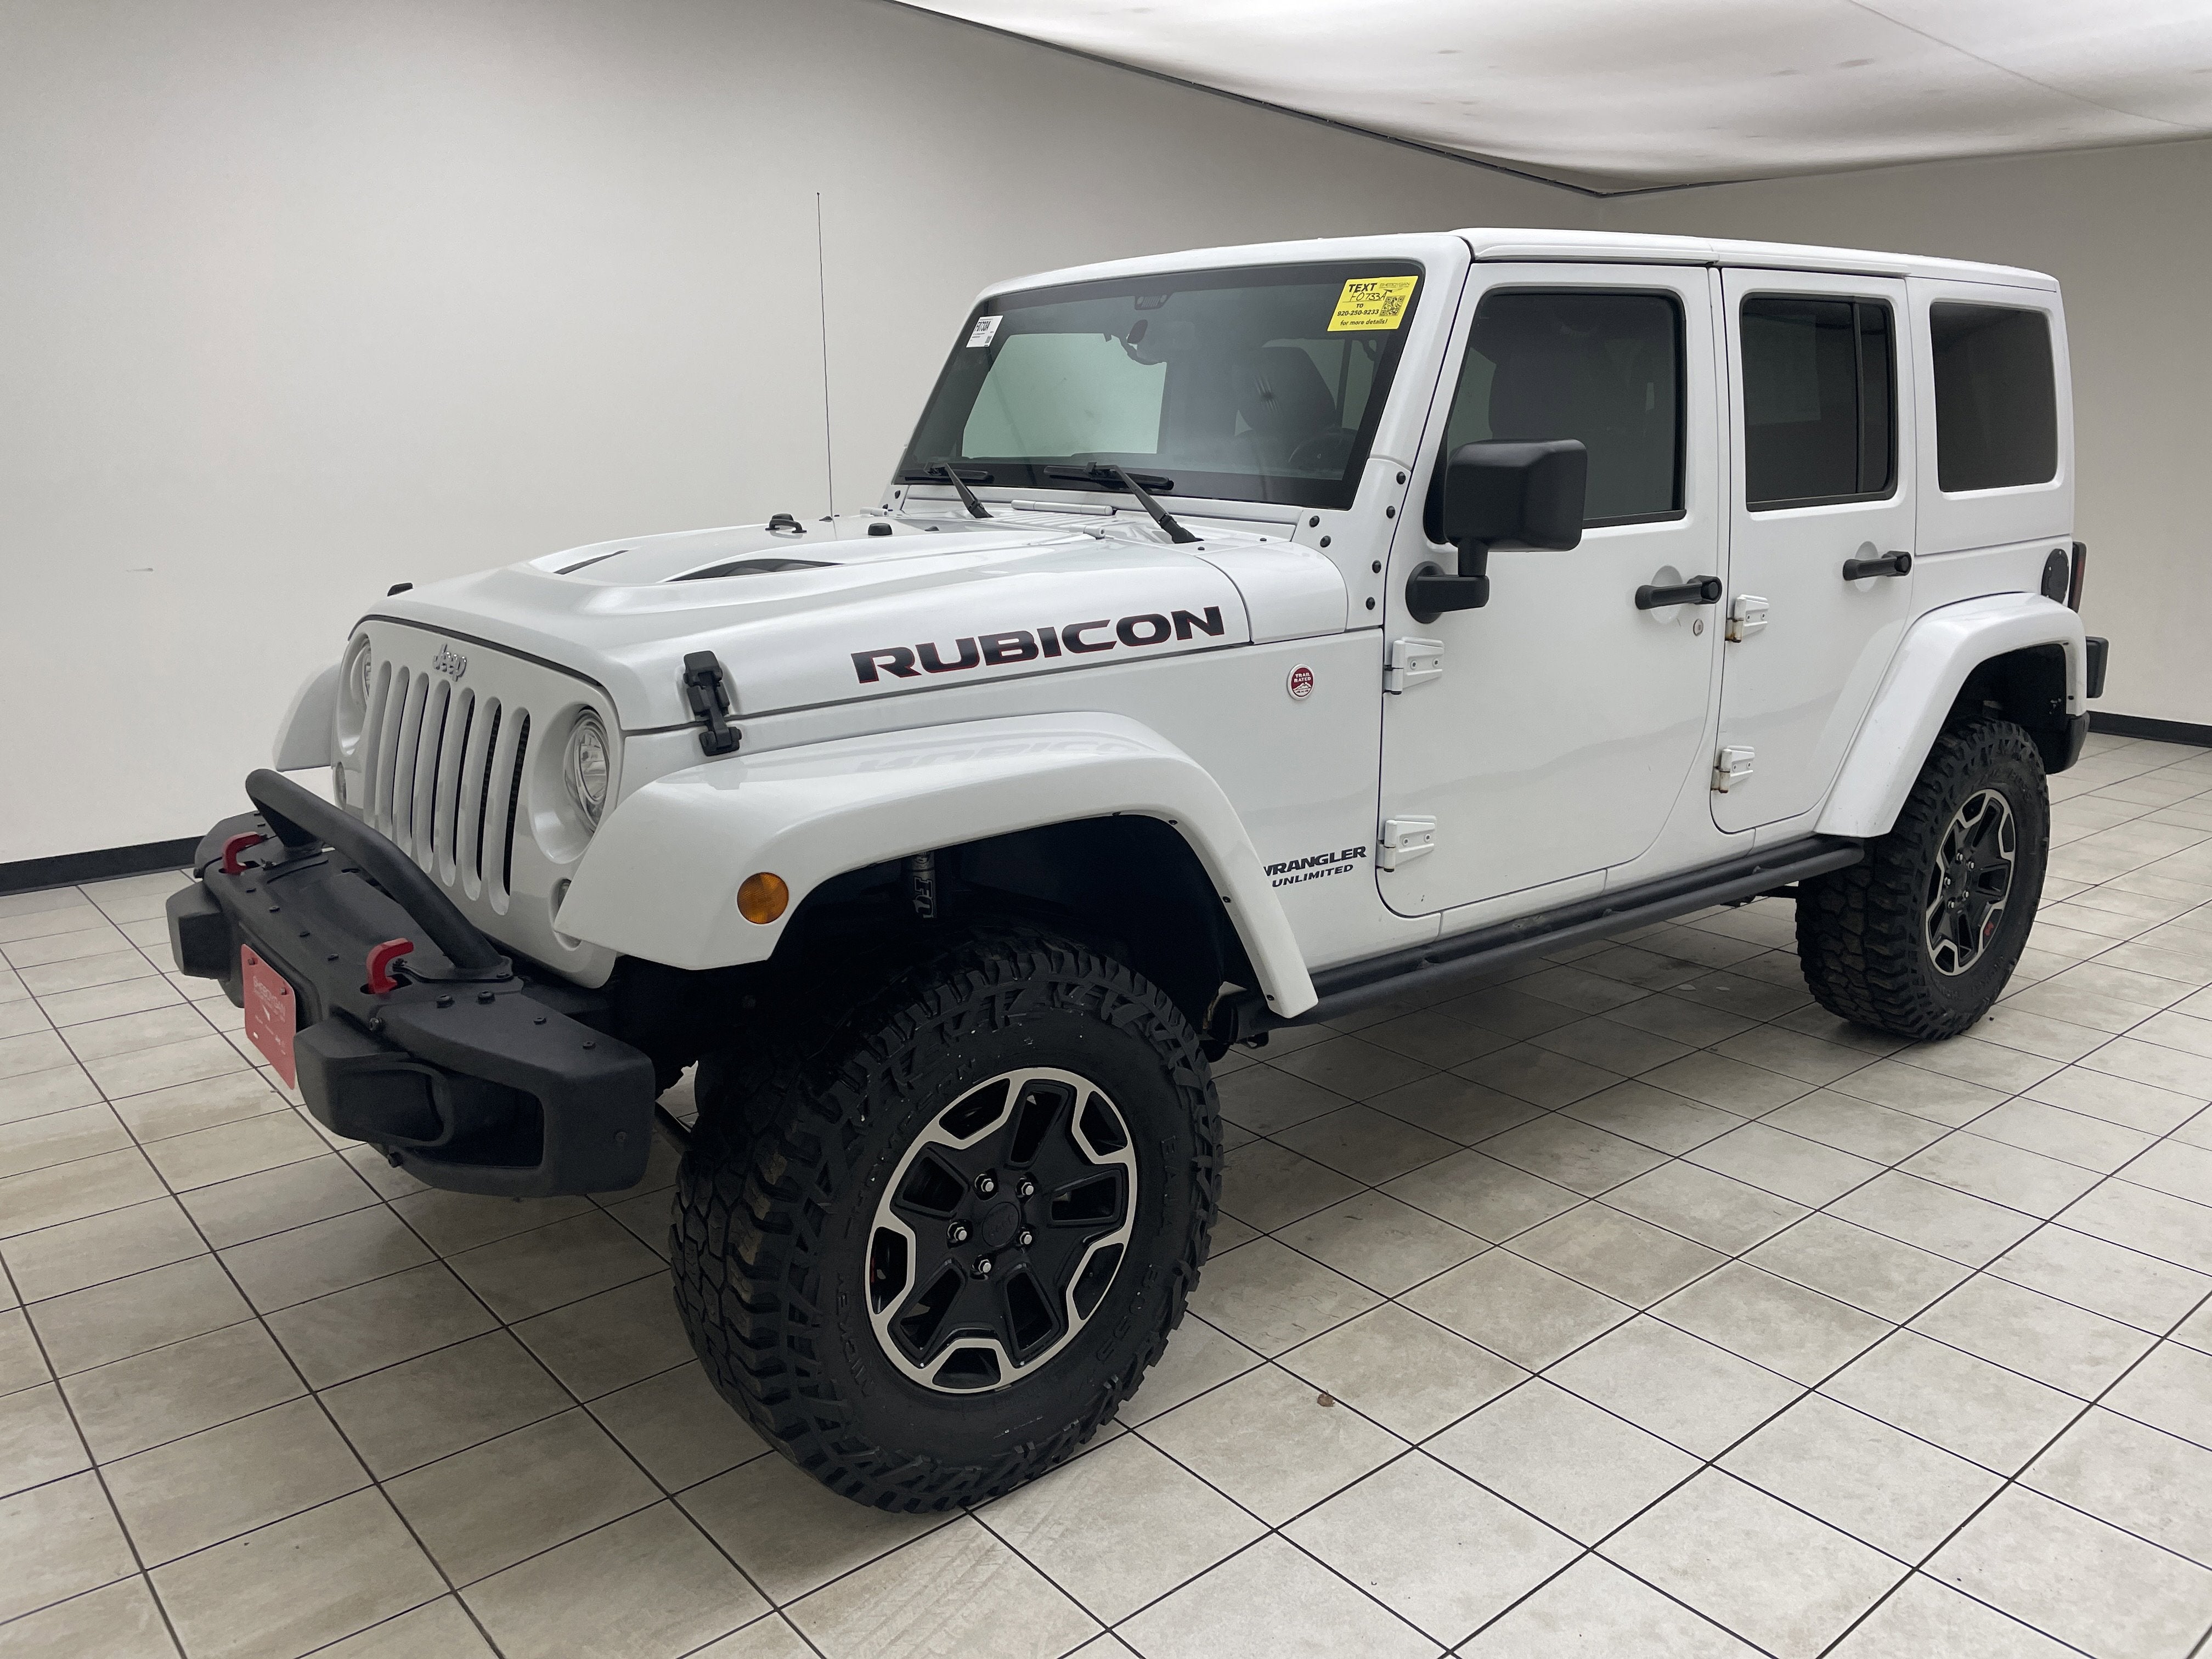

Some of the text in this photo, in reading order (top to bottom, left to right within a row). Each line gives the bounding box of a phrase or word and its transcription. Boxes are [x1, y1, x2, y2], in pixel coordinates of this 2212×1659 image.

[1348, 283, 1378, 292] TEXT
[850, 606, 1224, 684] RUBICON
[432, 644, 467, 682] Jeep
[1272, 864, 1353, 887] UNLIMITED
